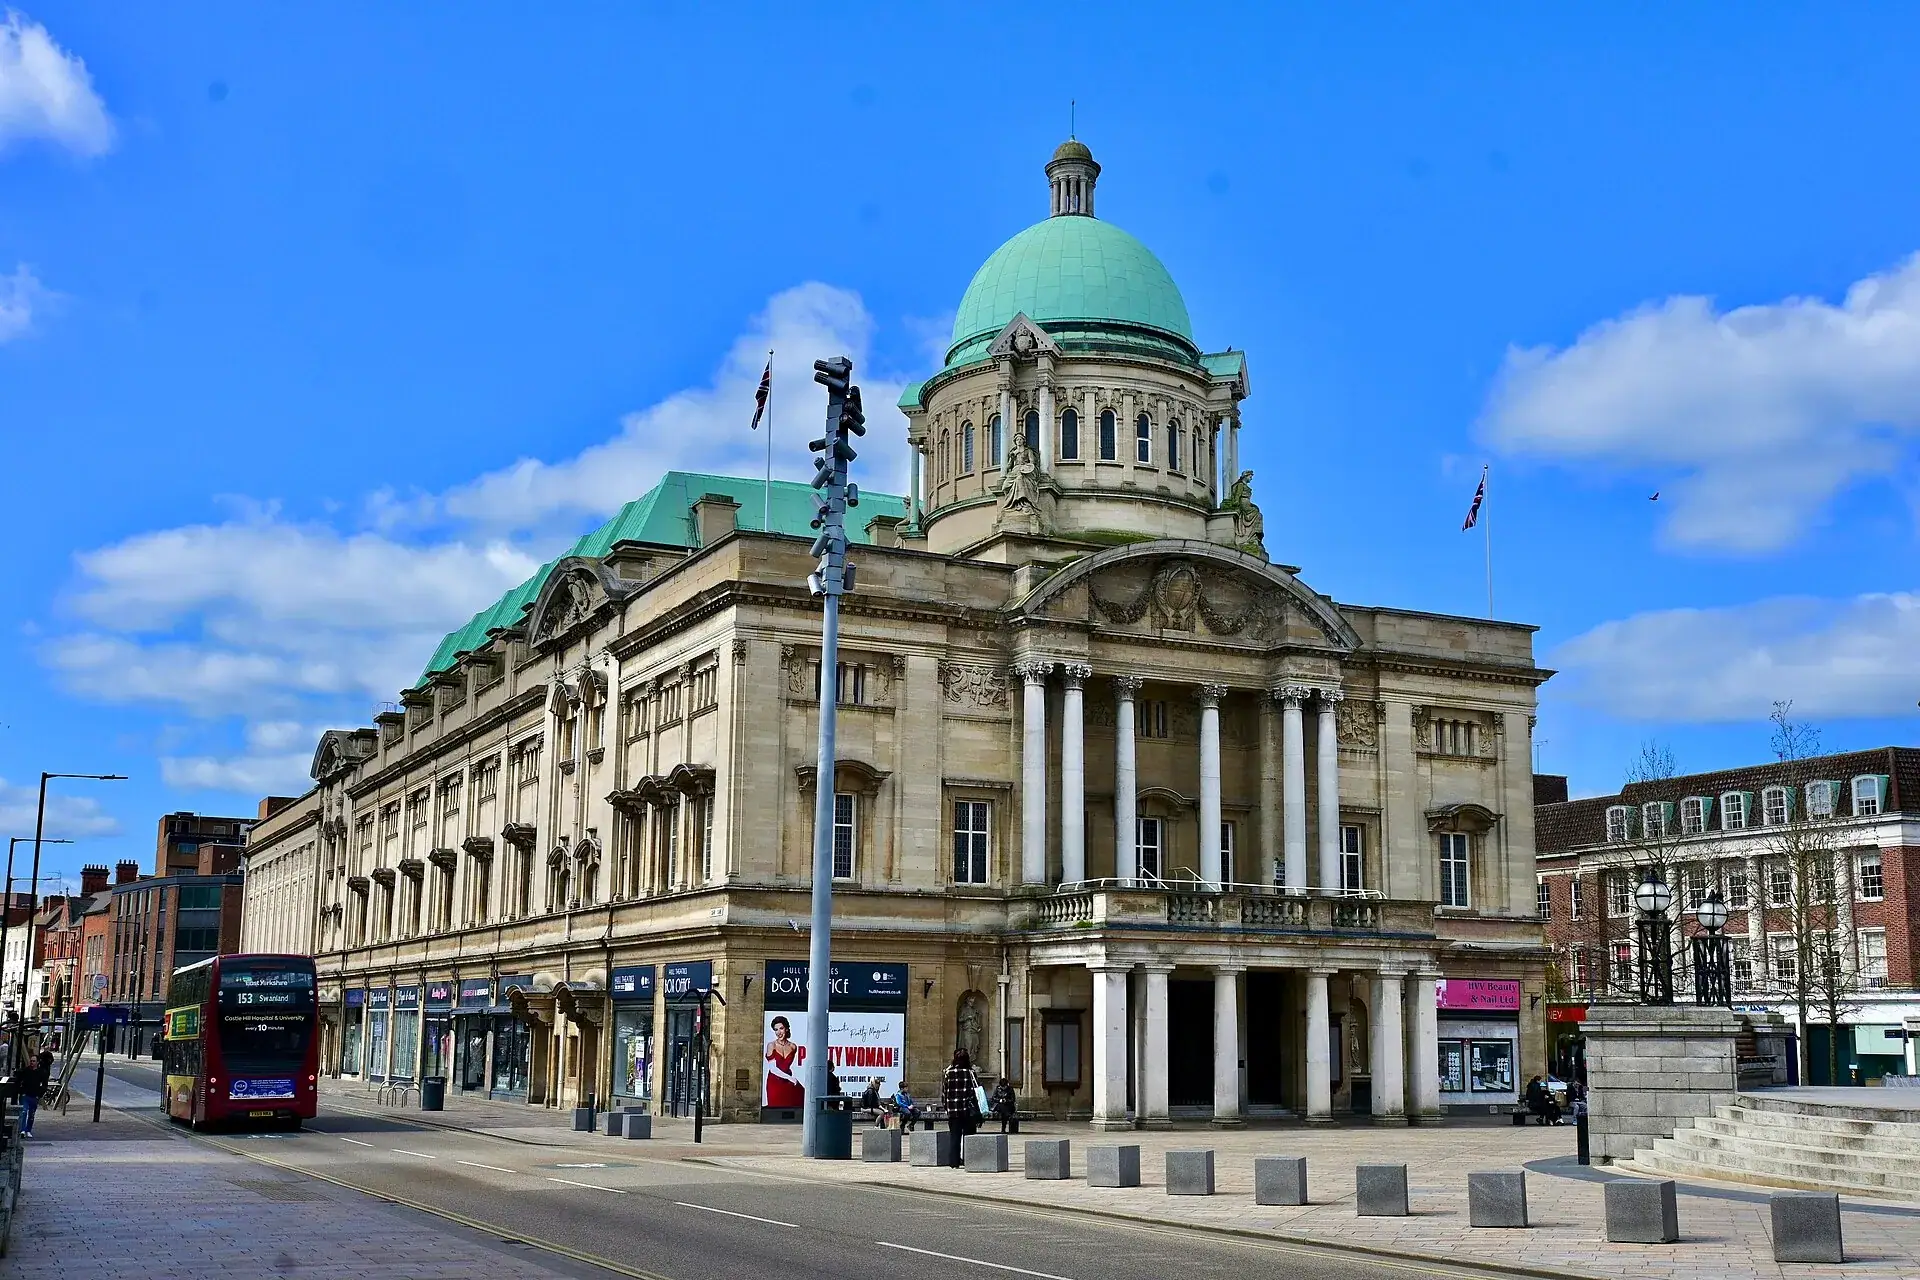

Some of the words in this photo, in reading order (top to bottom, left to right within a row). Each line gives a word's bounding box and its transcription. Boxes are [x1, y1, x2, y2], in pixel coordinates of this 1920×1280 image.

[771, 977, 801, 993] BOX
[806, 978, 849, 994] ICE
[1487, 982, 1517, 993] Beauty
[237, 993, 253, 1004] 153
[259, 994, 289, 1002] Swanland
[1471, 995, 1478, 1003] &
[1480, 995, 1497, 1003] Nail
[868, 1023, 890, 1039] Magical
[797, 1045, 843, 1067] PTY
[845, 1046, 893, 1067] WOMAN
